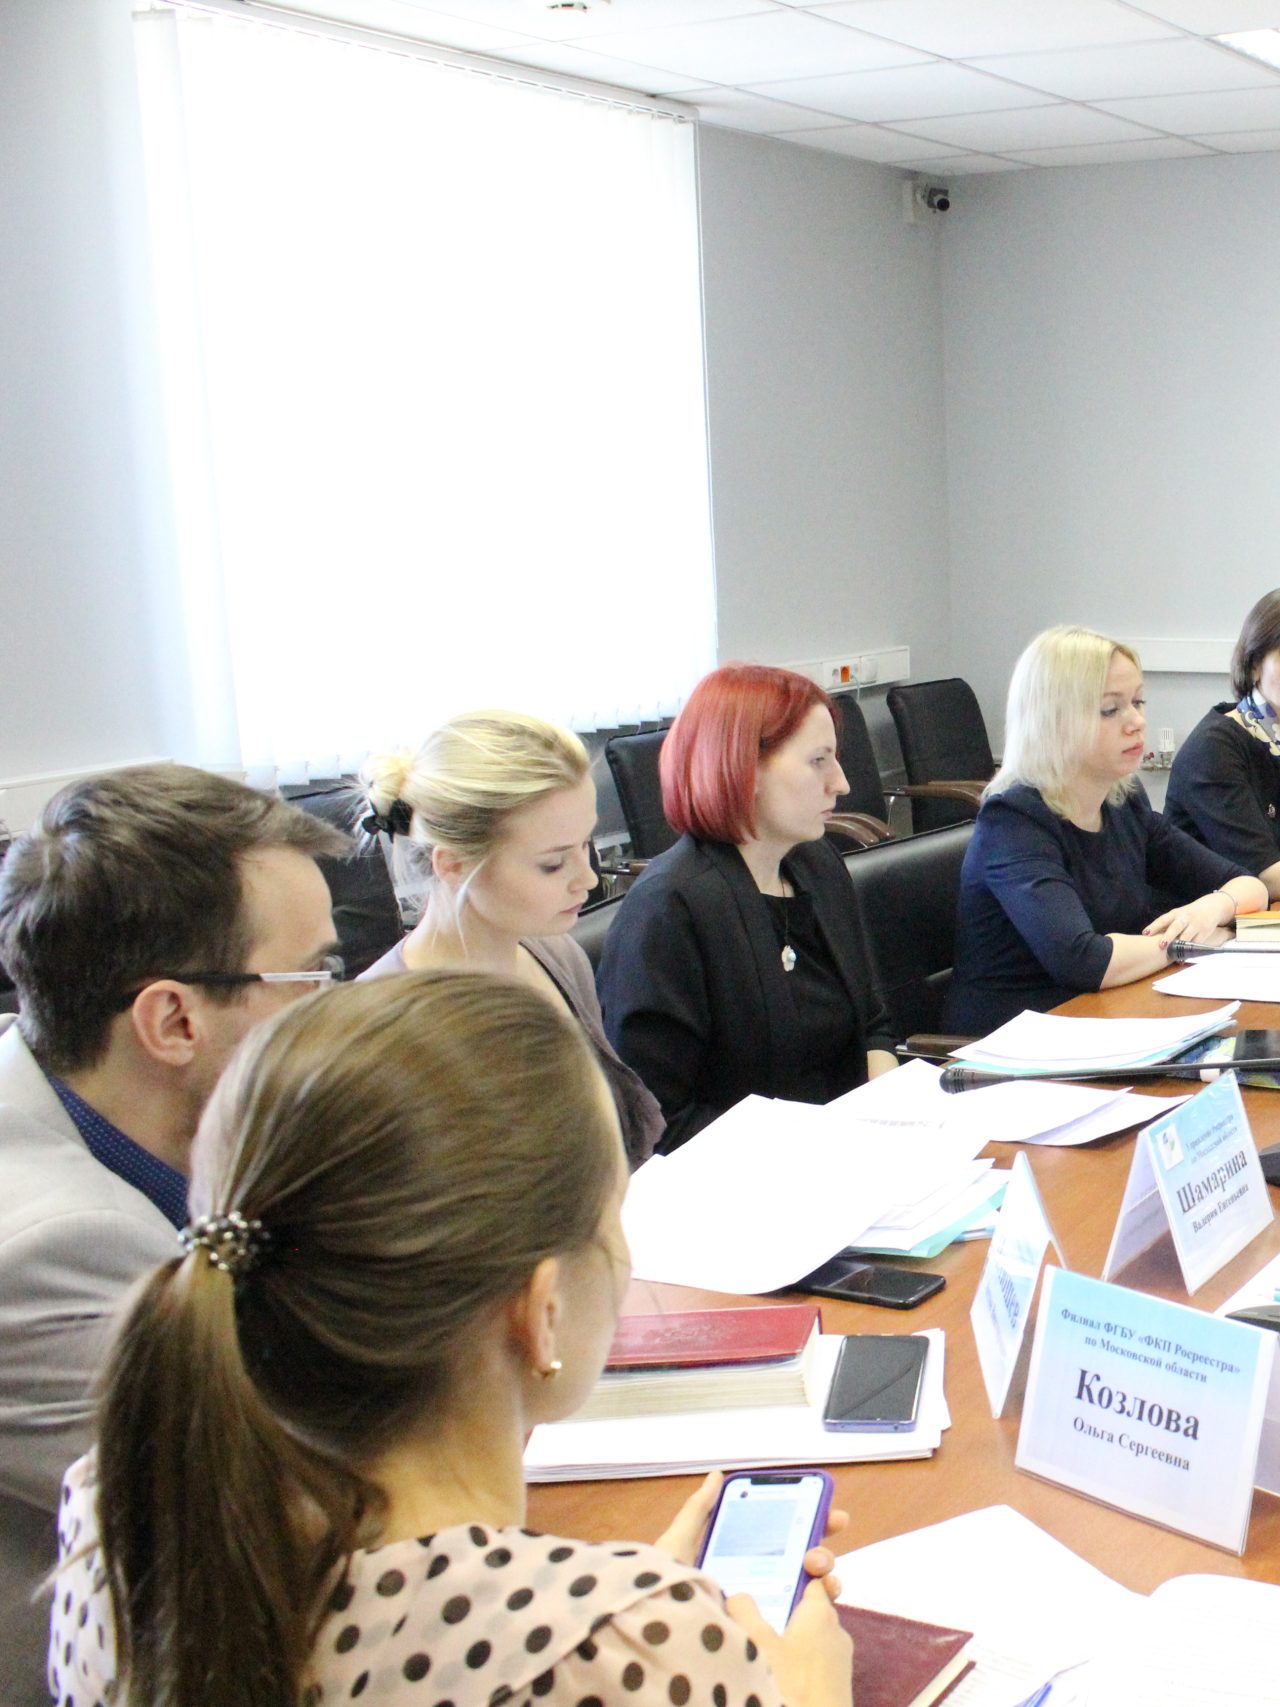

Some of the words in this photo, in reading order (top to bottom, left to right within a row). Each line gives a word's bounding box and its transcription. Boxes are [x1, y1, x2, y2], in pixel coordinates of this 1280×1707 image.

[1176, 1150, 1248, 1215] Шамарина
[1061, 1308, 1101, 1329] Филиал
[1103, 1322, 1136, 1340] ФГБУ
[1138, 1335, 1171, 1353] «ФКП
[1174, 1344, 1240, 1374] Росреестра»
[1084, 1336, 1097, 1347] по
[1099, 1338, 1162, 1368] Московской
[1165, 1362, 1207, 1383] области
[1075, 1368, 1200, 1440] Козлова
[1073, 1416, 1114, 1443] Ольга
[1118, 1433, 1190, 1471] Сергеевна
